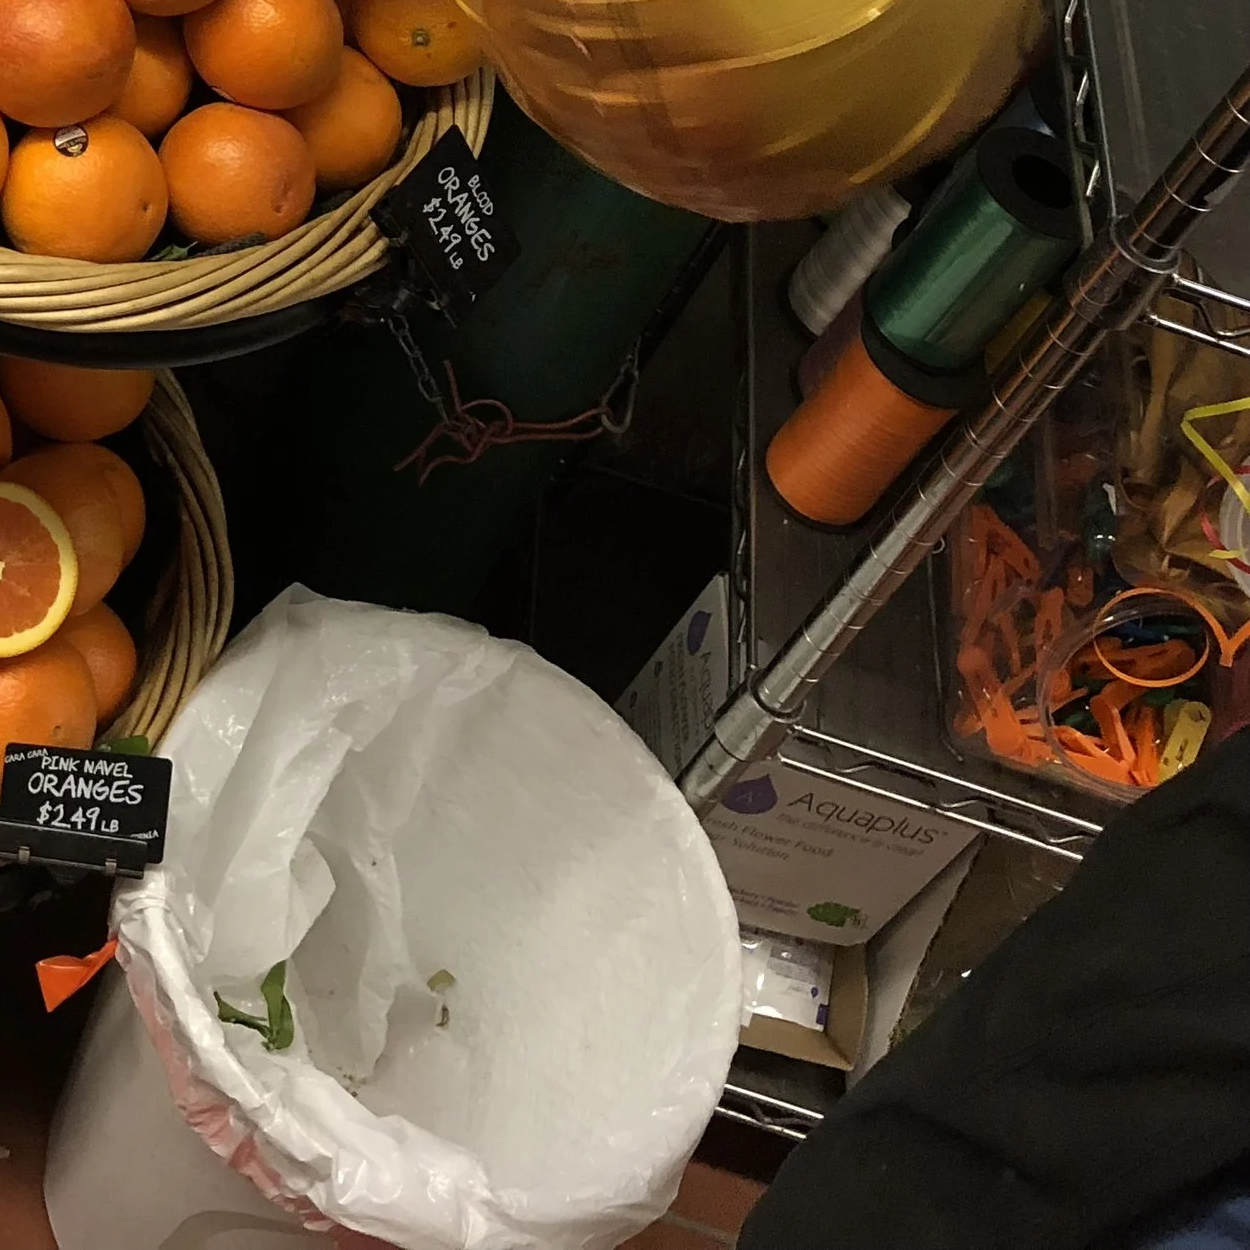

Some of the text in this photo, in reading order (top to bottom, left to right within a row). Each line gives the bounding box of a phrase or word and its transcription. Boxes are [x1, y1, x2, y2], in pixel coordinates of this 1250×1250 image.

[468, 174, 494, 216] BLOOD
[438, 166, 495, 262] ORANGES
[449, 251, 464, 270] LB
[4, 752, 26, 764] CARA
[41, 755, 133, 778] PINK NAVEL
[27, 772, 144, 805] ORANGES
[101, 819, 119, 833] LB
[786, 792, 940, 845] Aquaplus
